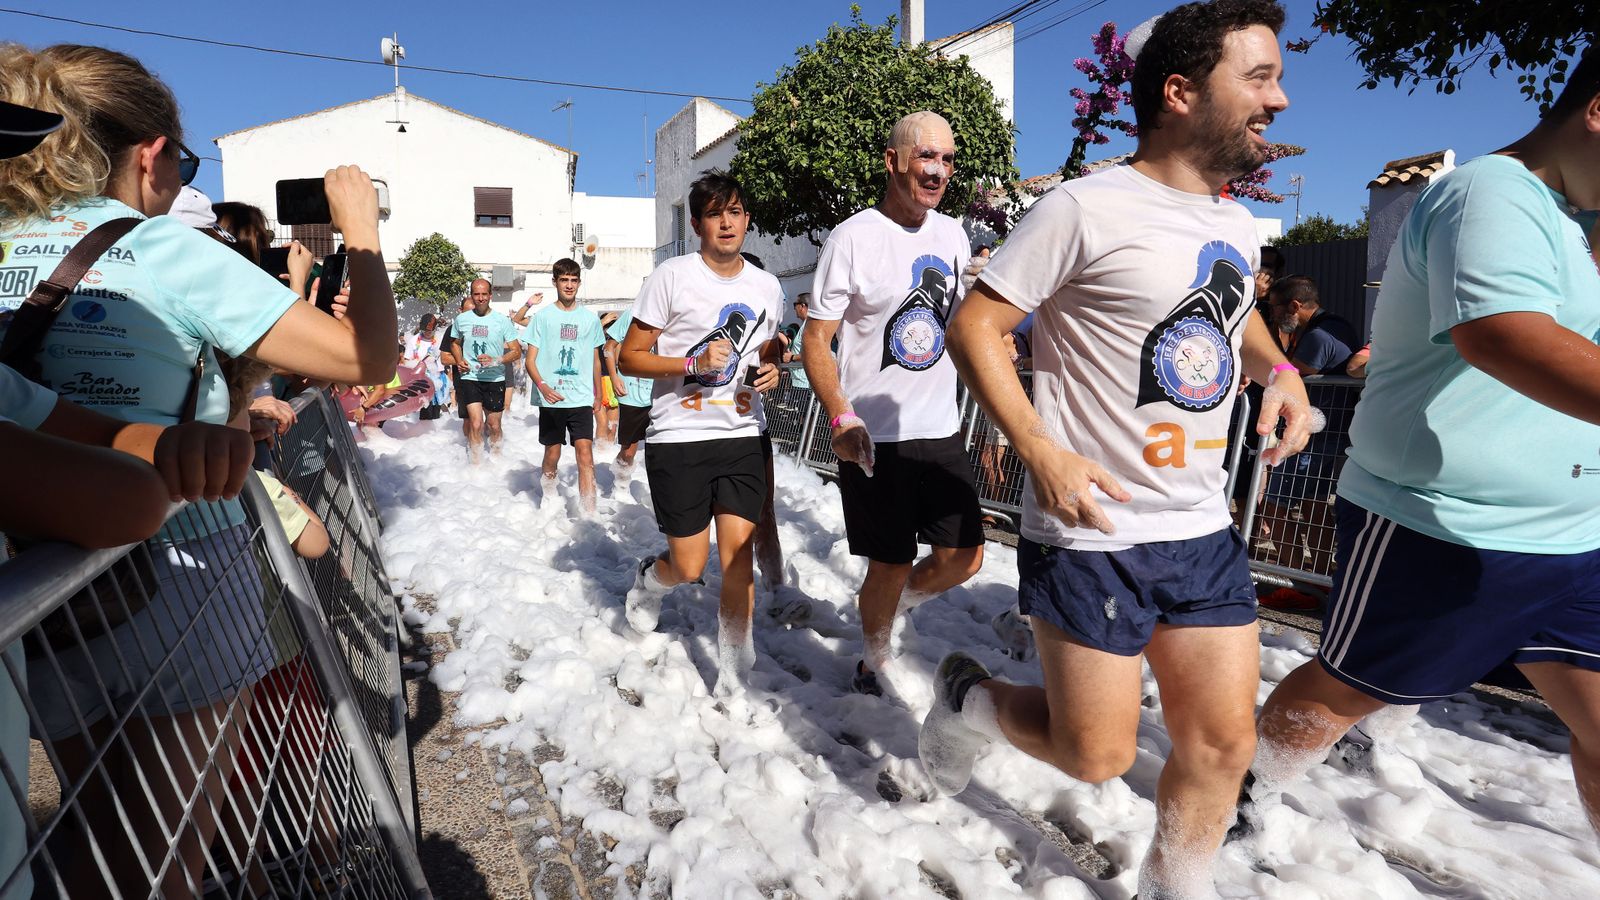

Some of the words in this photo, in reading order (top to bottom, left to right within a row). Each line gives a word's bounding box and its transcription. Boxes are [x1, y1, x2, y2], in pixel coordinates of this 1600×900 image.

[1164, 337, 1178, 362] JEREZ
[1177, 328, 1190, 339] DE
[73, 371, 115, 385] Bar
